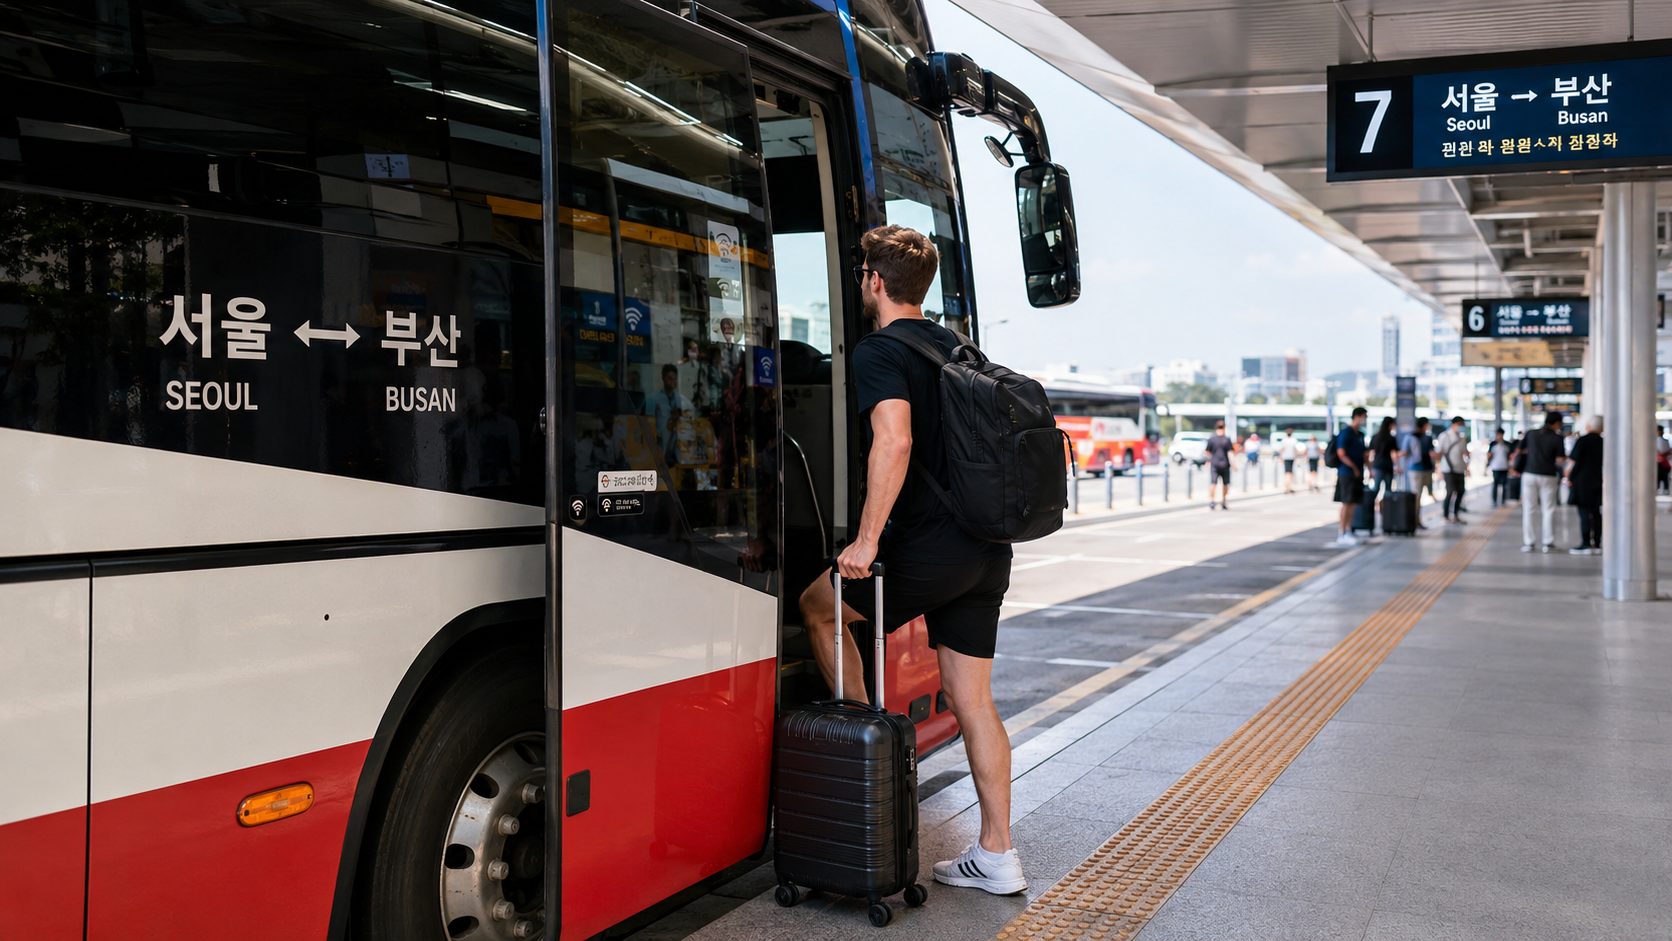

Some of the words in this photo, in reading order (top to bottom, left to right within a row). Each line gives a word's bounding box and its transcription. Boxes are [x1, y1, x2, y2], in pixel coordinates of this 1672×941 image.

[1441, 82, 1499, 113] 서울
[1550, 73, 1612, 107] 부산
[1354, 90, 1392, 154] 7
[1446, 115, 1491, 132] Seoul
[1558, 110, 1608, 125] Busan
[159, 293, 271, 360] 서울
[381, 310, 461, 368] 부산
[1468, 305, 1485, 332] 6
[165, 380, 258, 411] SEOUL
[386, 386, 456, 412] BUSAN
